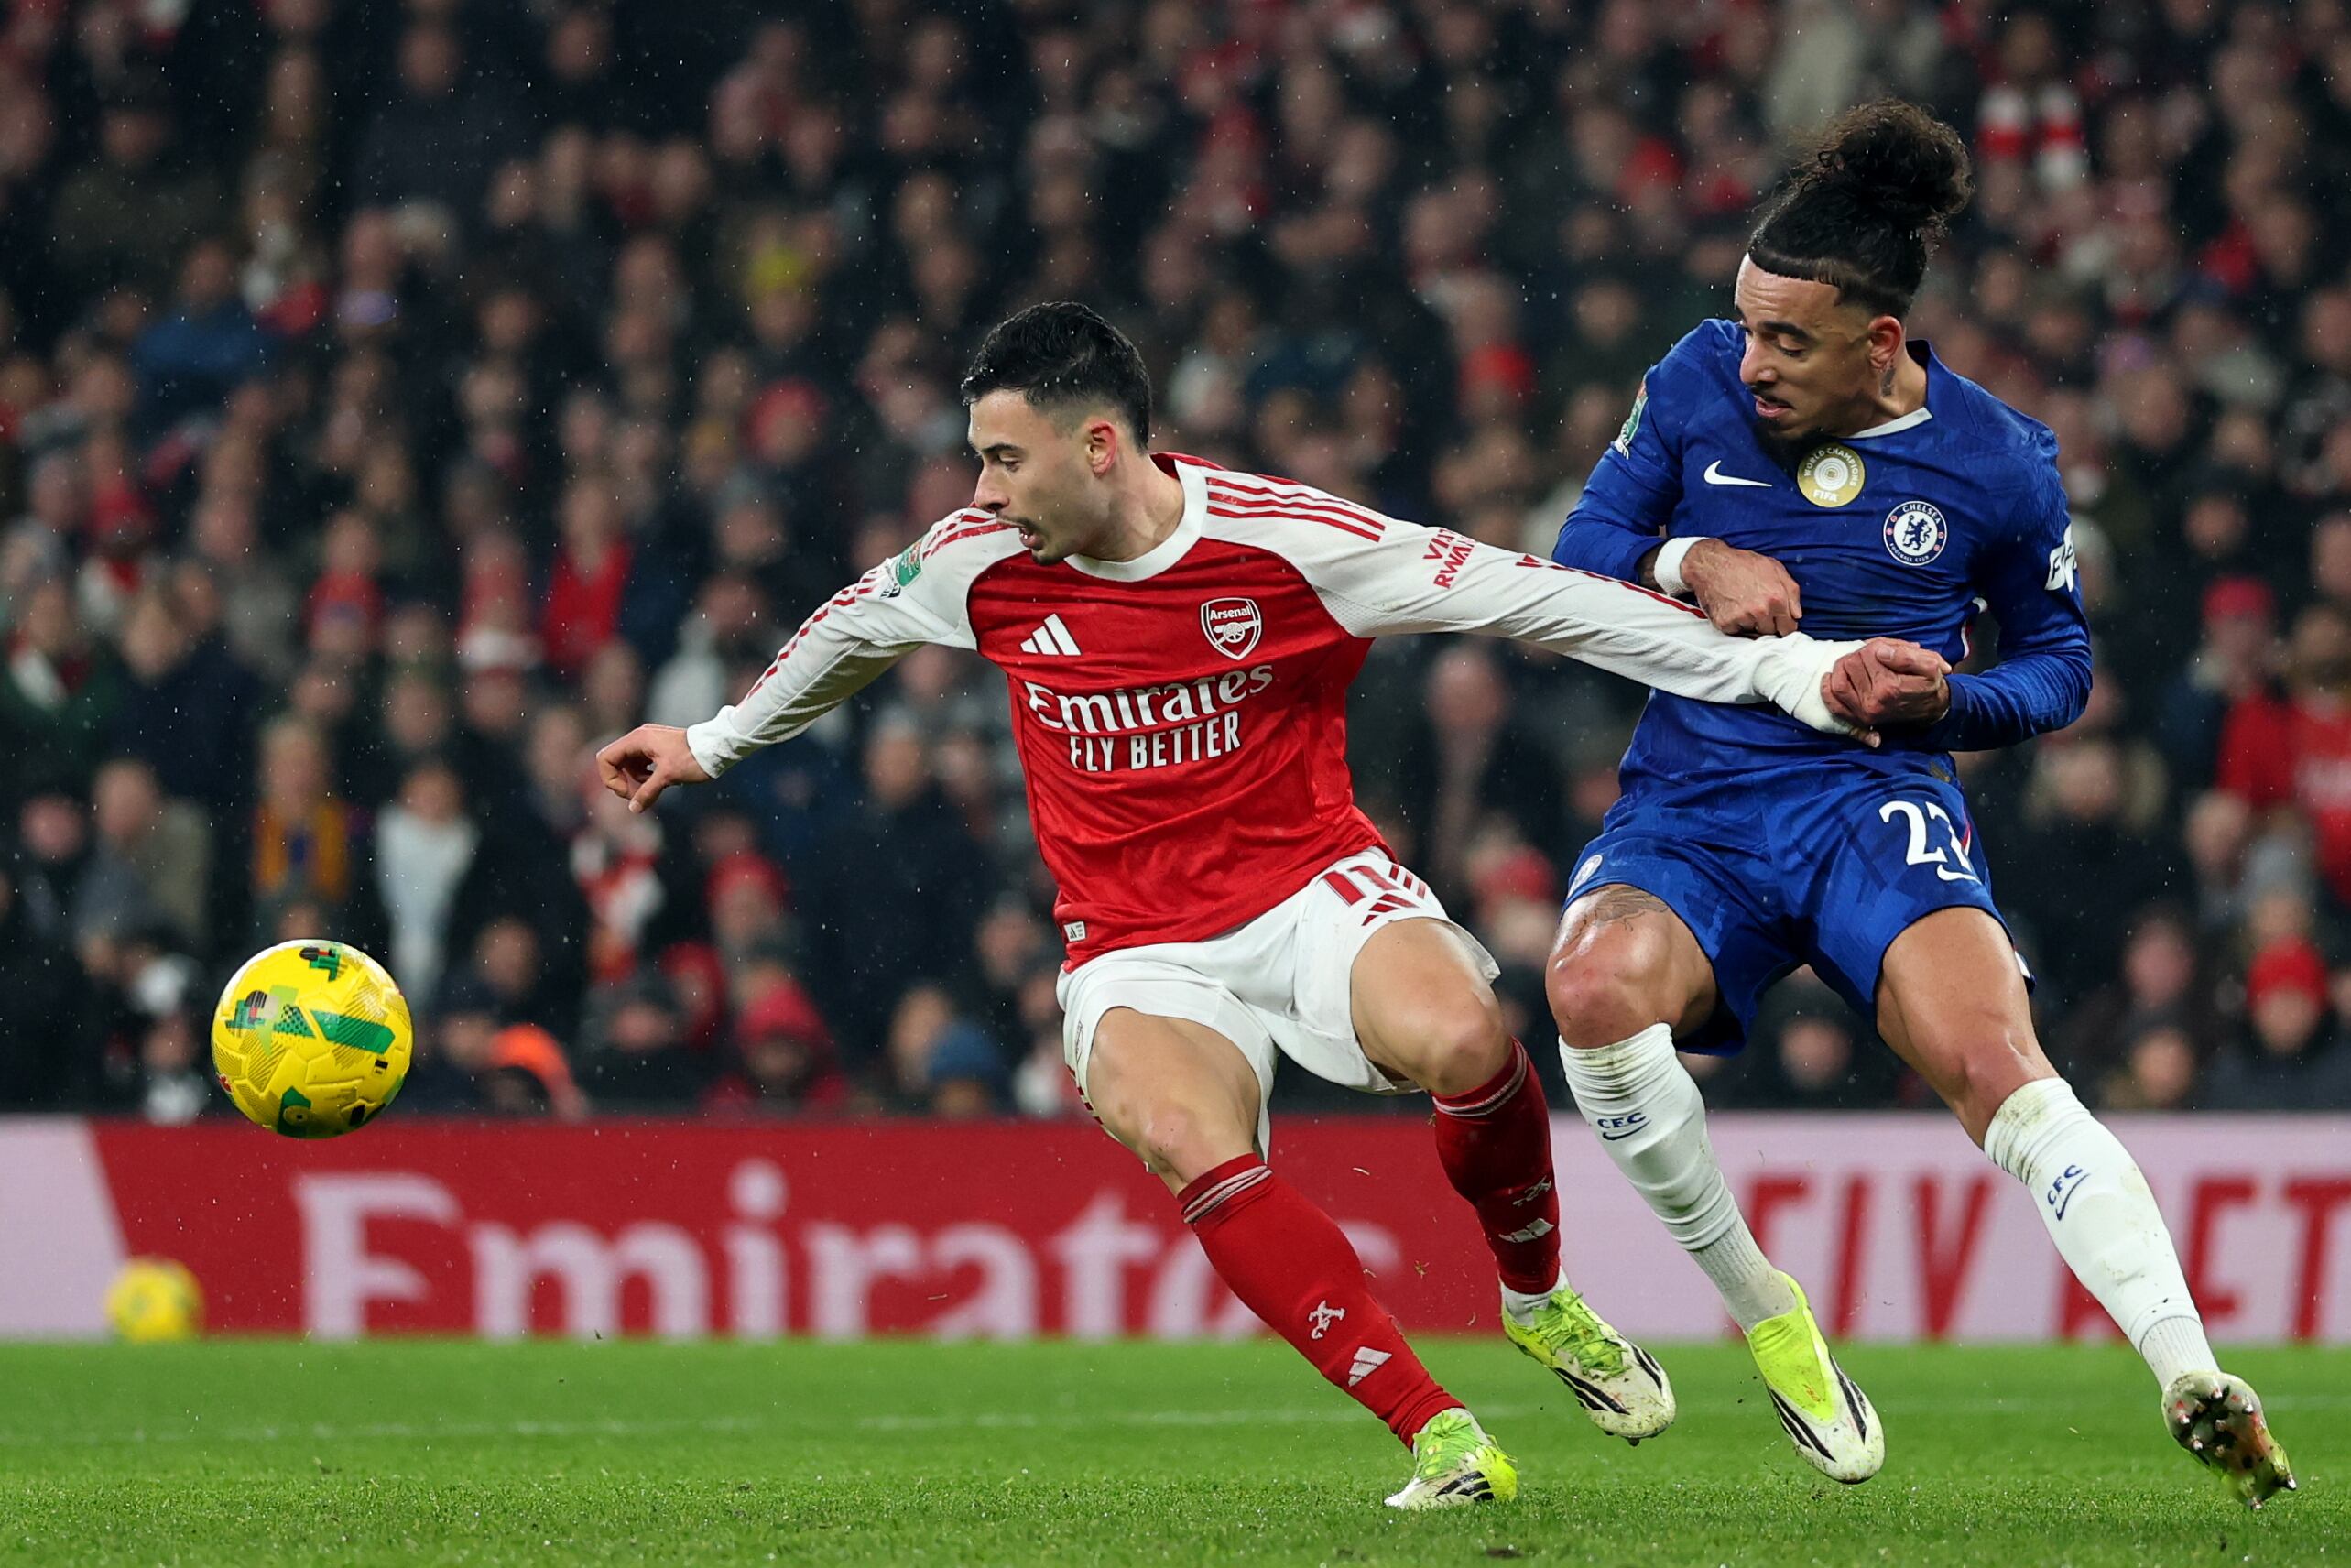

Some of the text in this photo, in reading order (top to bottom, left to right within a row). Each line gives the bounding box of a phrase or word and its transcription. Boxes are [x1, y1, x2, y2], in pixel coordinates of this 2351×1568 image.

[1804, 447, 1860, 487] WORLD CHAMPIONS
[1812, 489, 1838, 503] FIFA
[1902, 504, 1942, 525] CHELSEA
[1210, 605, 1252, 621] Arsenal
[1024, 665, 1273, 734] Emirates
[1070, 711, 1241, 771] FLY BETTER
[1597, 1112, 1647, 1128] CFC
[2047, 1164, 2083, 1206] CFC
